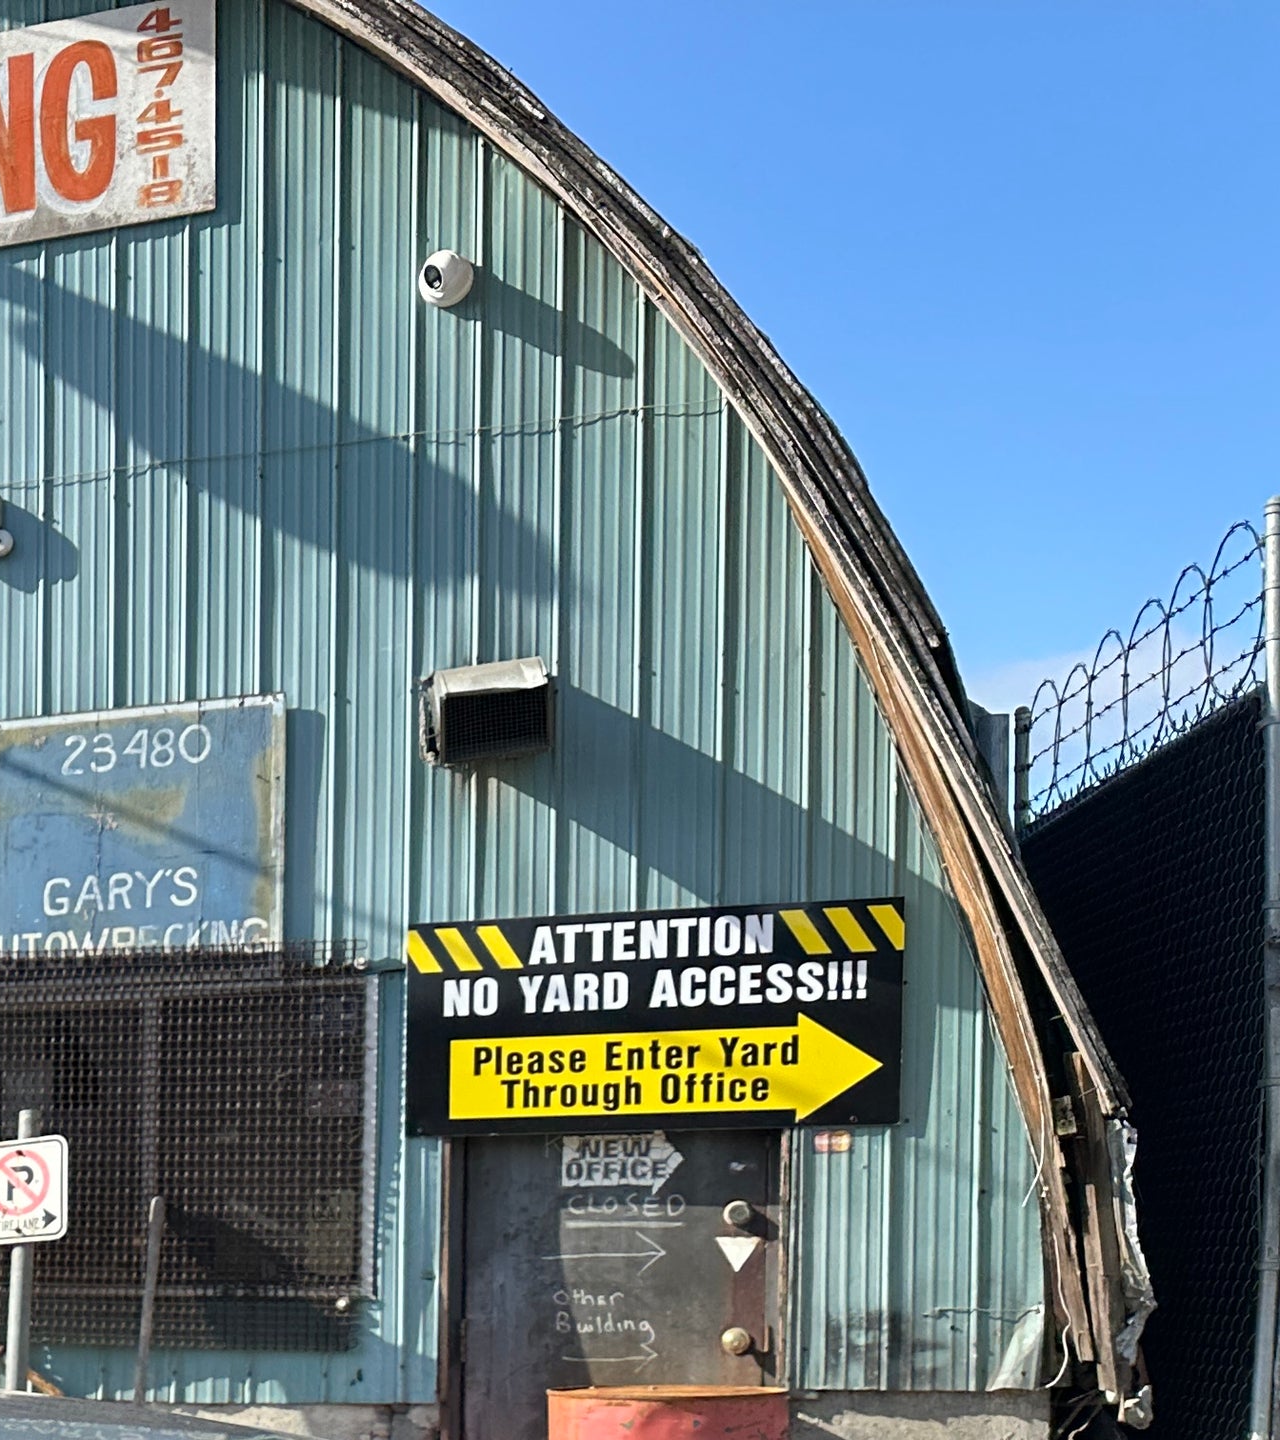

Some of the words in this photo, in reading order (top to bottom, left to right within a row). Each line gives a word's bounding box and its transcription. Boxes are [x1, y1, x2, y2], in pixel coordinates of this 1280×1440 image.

[61, 723, 212, 776] 23480
[42, 866, 199, 918] GARY'S
[528, 913, 774, 966] ATTENTION
[443, 976, 499, 1018] NO
[518, 971, 630, 1014] YARD
[648, 959, 868, 1009] ACCESS!!!
[473, 1045, 587, 1077] Please
[605, 1039, 701, 1072] Enter
[718, 1033, 800, 1068] Yard
[500, 1074, 642, 1111] Through
[660, 1071, 770, 1105] Office
[578, 1135, 652, 1159] NEW
[565, 1158, 670, 1182] OFFICE
[16, 1217, 41, 1231] LANE
[567, 1193, 686, 1217] CLOSED
[555, 1310, 656, 1344] Building
